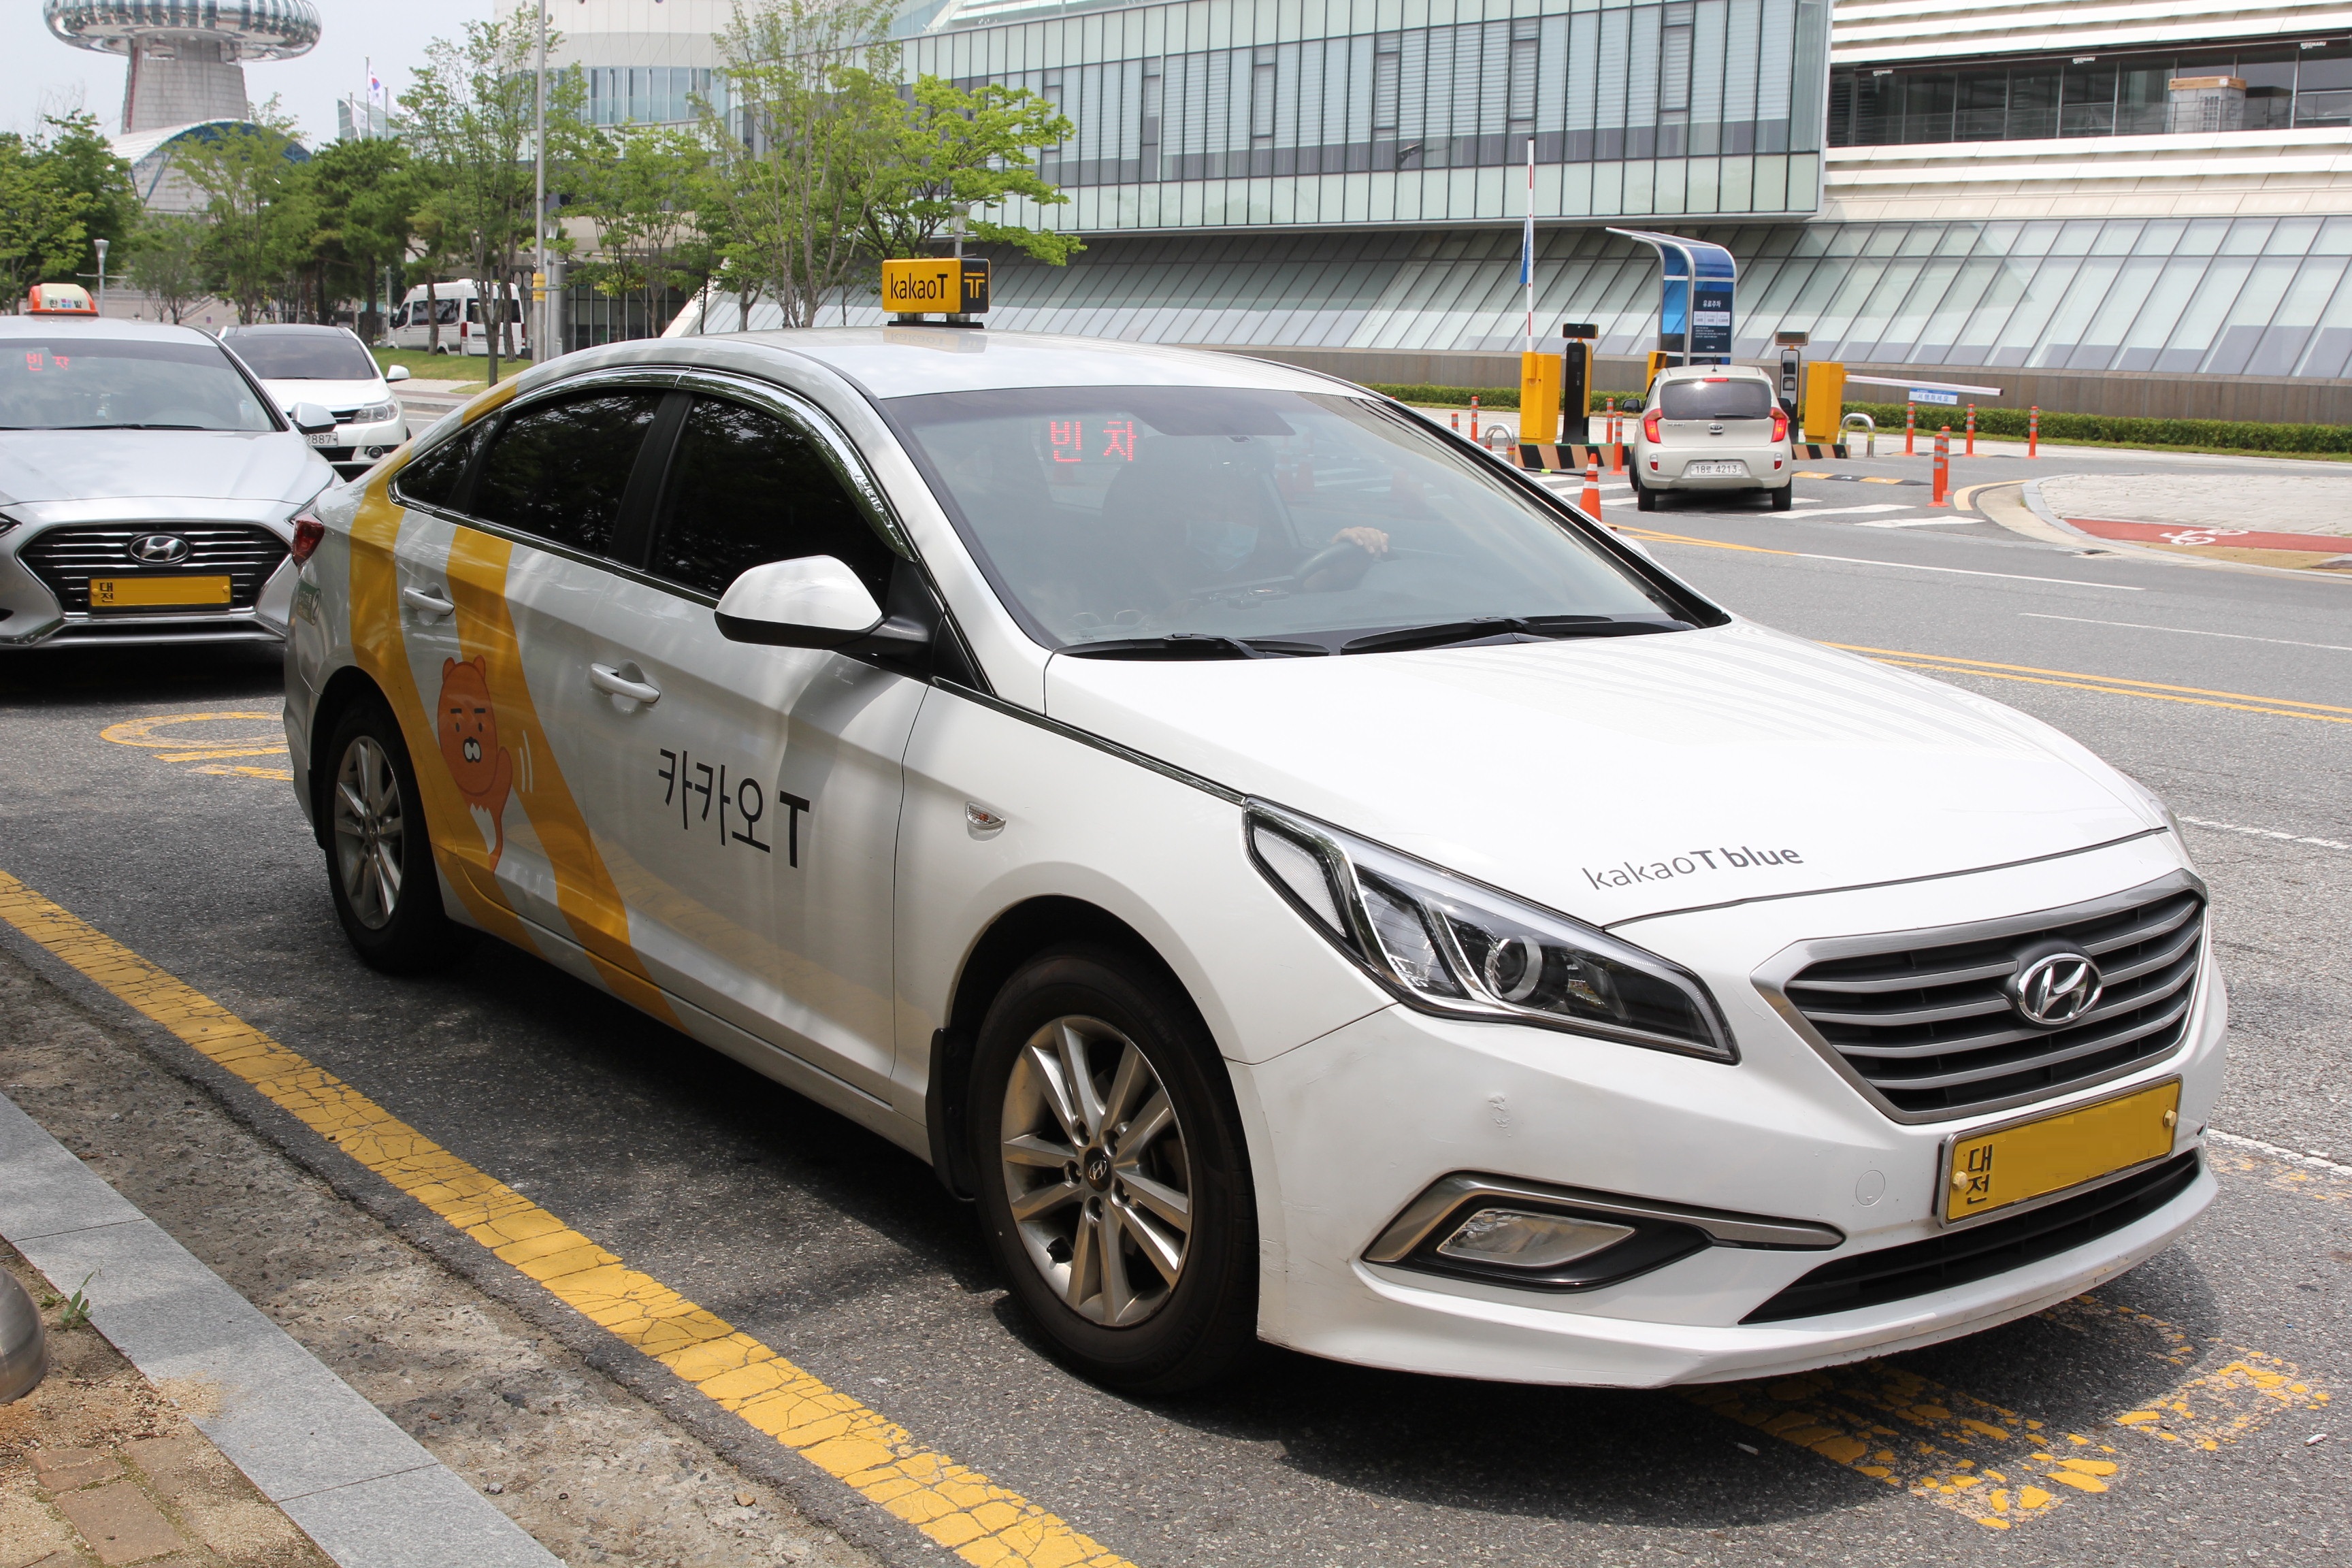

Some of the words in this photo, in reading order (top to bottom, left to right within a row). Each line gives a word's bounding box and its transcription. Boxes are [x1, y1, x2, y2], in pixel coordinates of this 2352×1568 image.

[891, 272, 948, 299] kakaoT
[1716, 465, 1737, 474] 4213
[1718, 845, 1805, 868] blue
[1966, 1143, 1993, 1205] 대전
